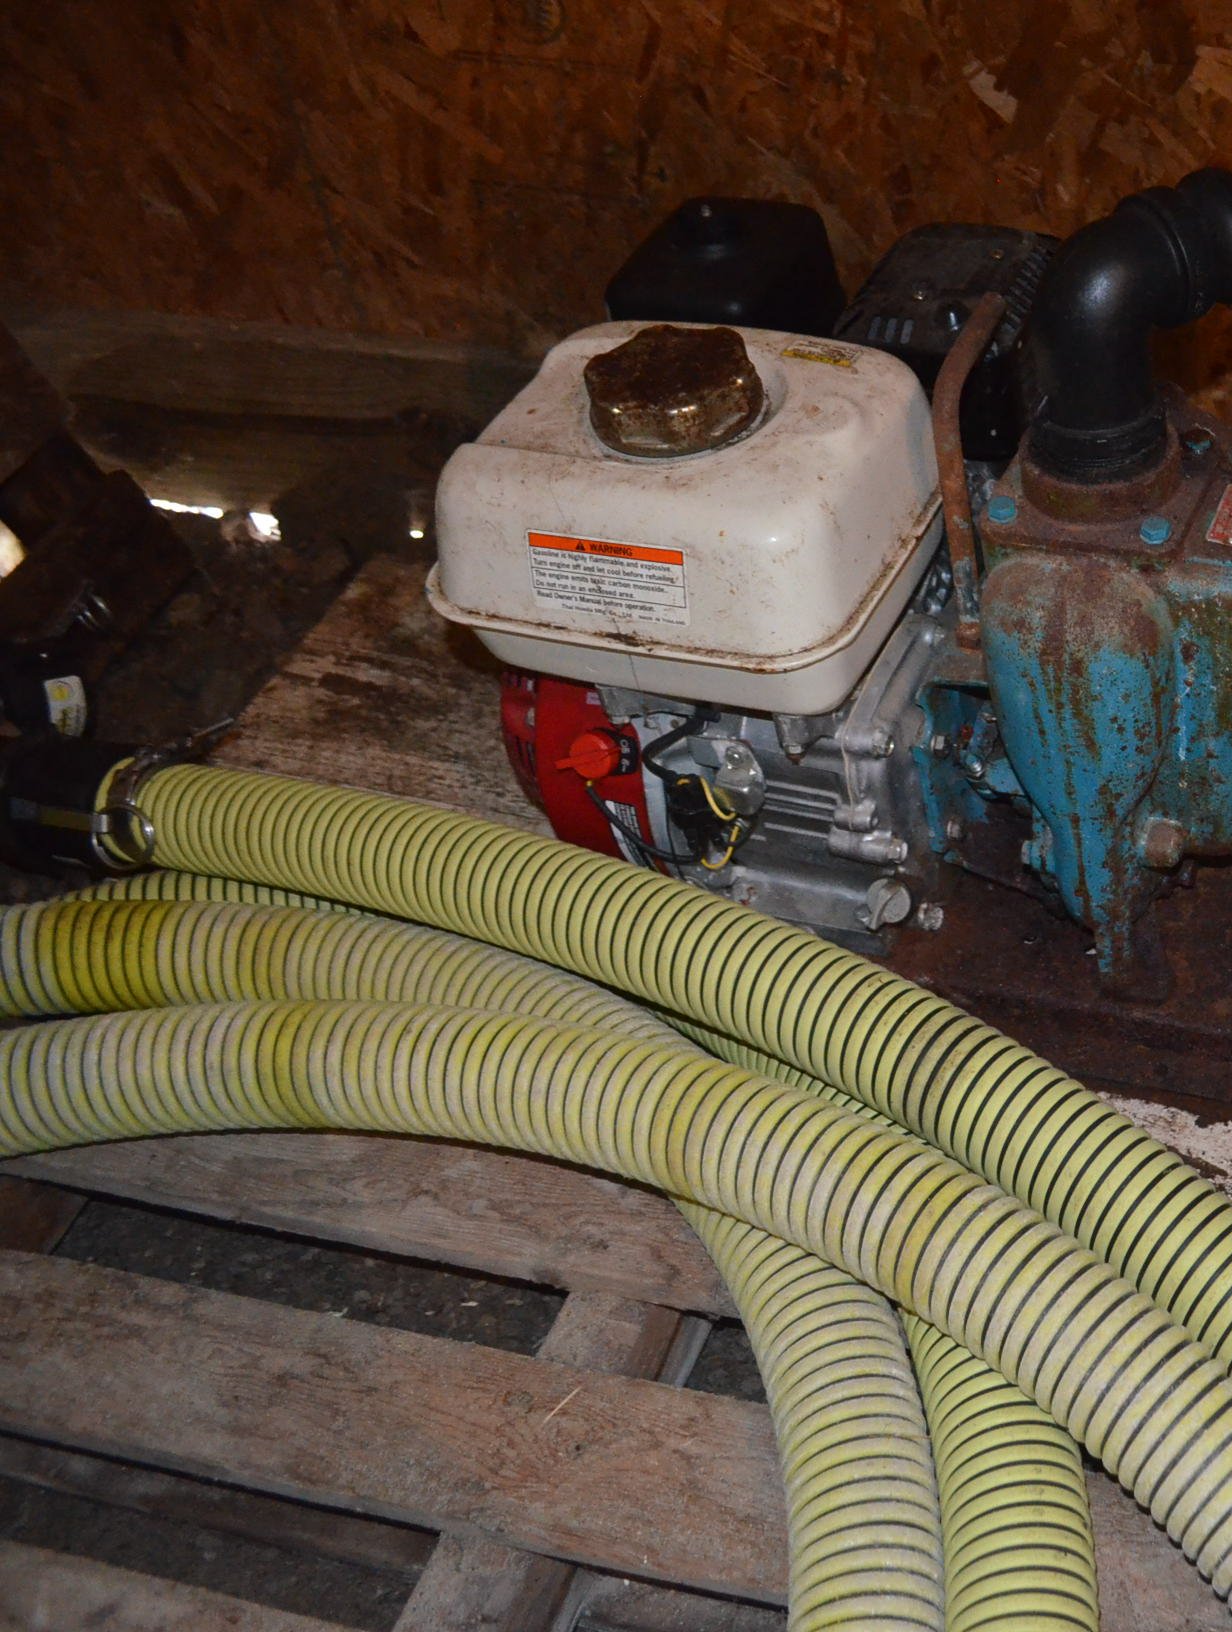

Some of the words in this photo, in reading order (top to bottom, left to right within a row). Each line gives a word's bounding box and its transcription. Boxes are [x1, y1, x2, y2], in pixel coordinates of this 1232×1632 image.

[532, 548, 559, 557] Gasoline
[568, 552, 587, 562] highly
[590, 543, 633, 556] WARNING
[533, 557, 547, 566] Turn
[549, 561, 570, 569] engine
[606, 568, 621, 576] cool
[622, 569, 643, 578] before
[535, 569, 546, 577] The
[548, 572, 570, 580] engine
[571, 575, 588, 583] emits
[608, 580, 631, 588] carbon
[558, 582, 569, 590] run
[537, 590, 552, 598] Read
[554, 592, 578, 601] Owner's
[579, 595, 602, 605] Manual
[603, 599, 623, 607] before
